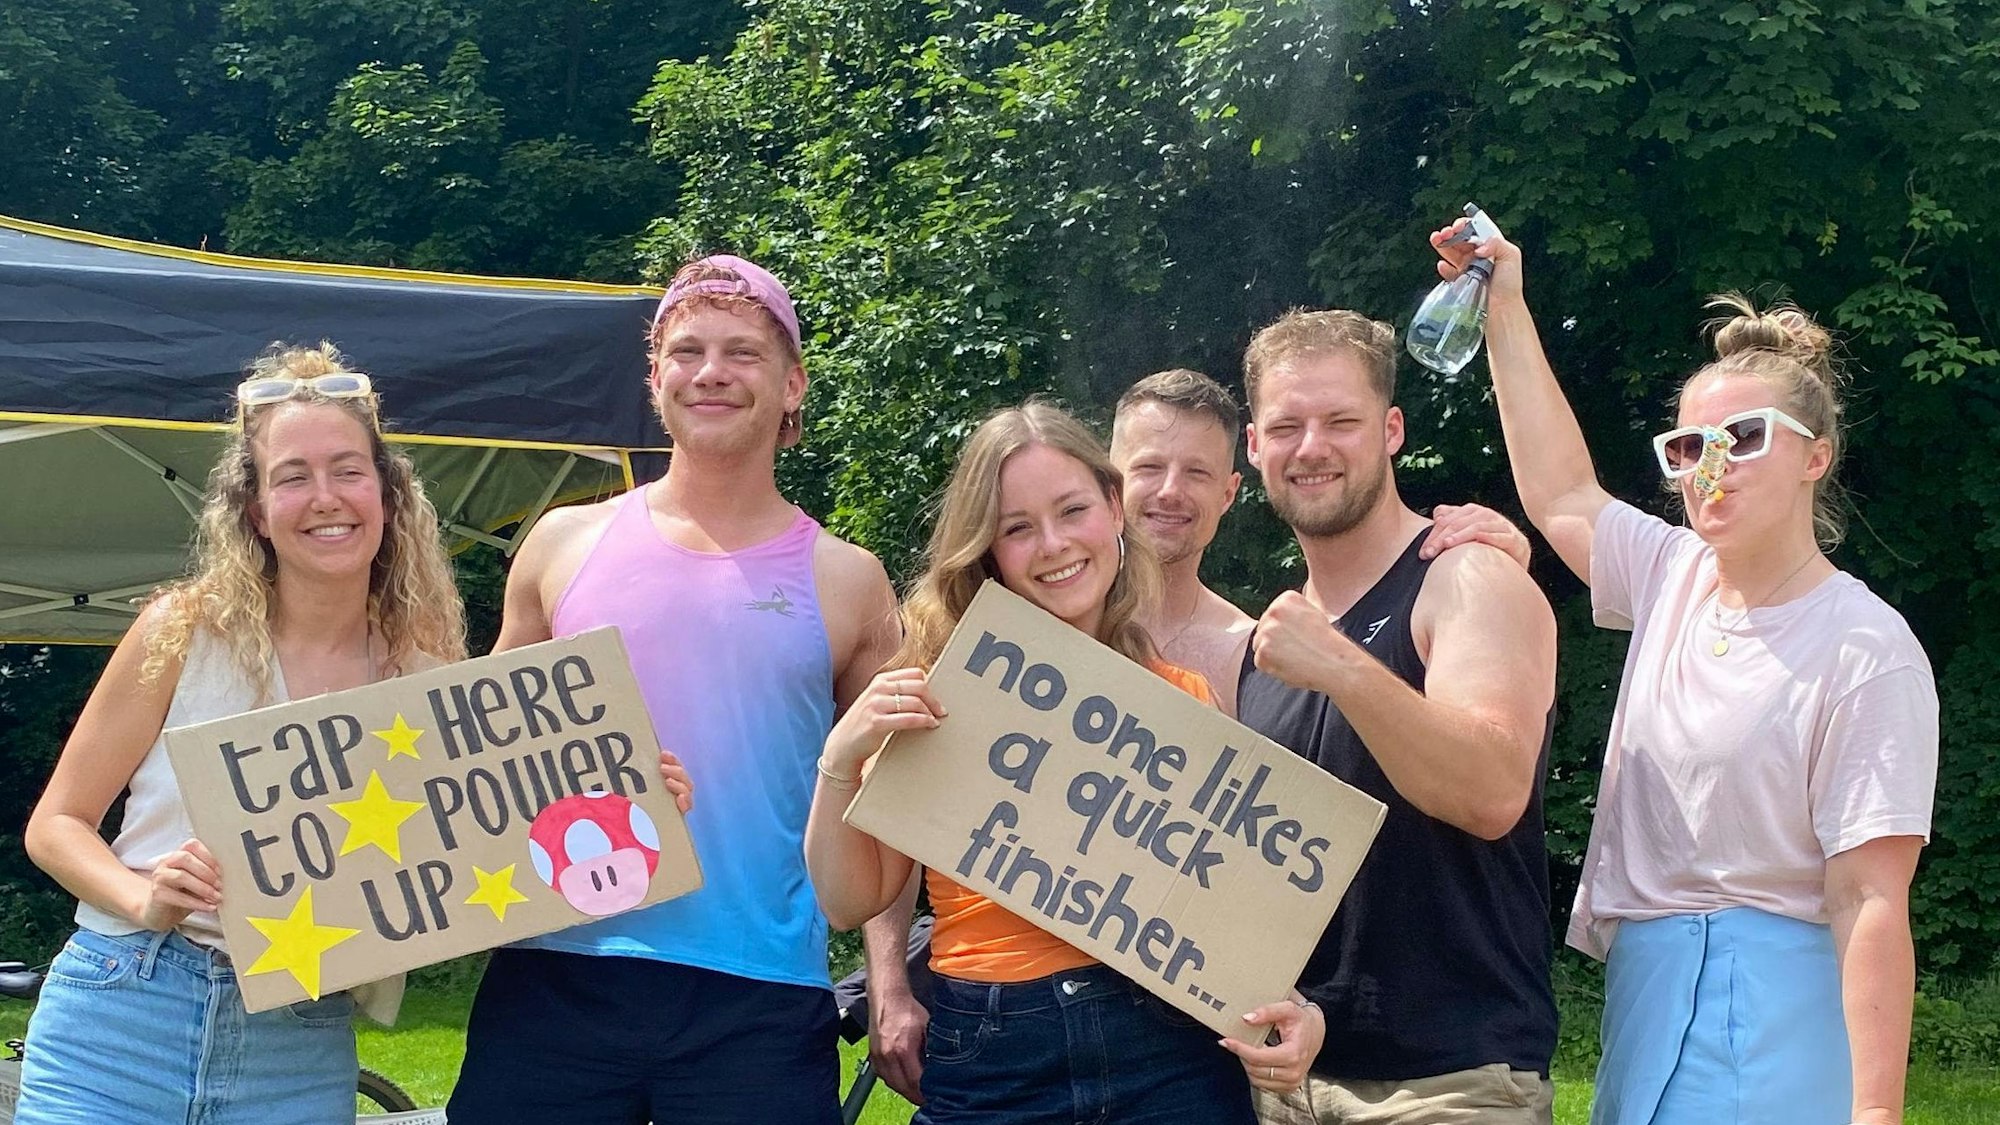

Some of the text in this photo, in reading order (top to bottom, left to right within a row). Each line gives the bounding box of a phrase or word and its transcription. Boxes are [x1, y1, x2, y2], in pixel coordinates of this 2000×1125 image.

[965, 630, 1331, 892] no one likes
[988, 732, 1225, 888] a quick
[956, 800, 1226, 1011] finisher...
